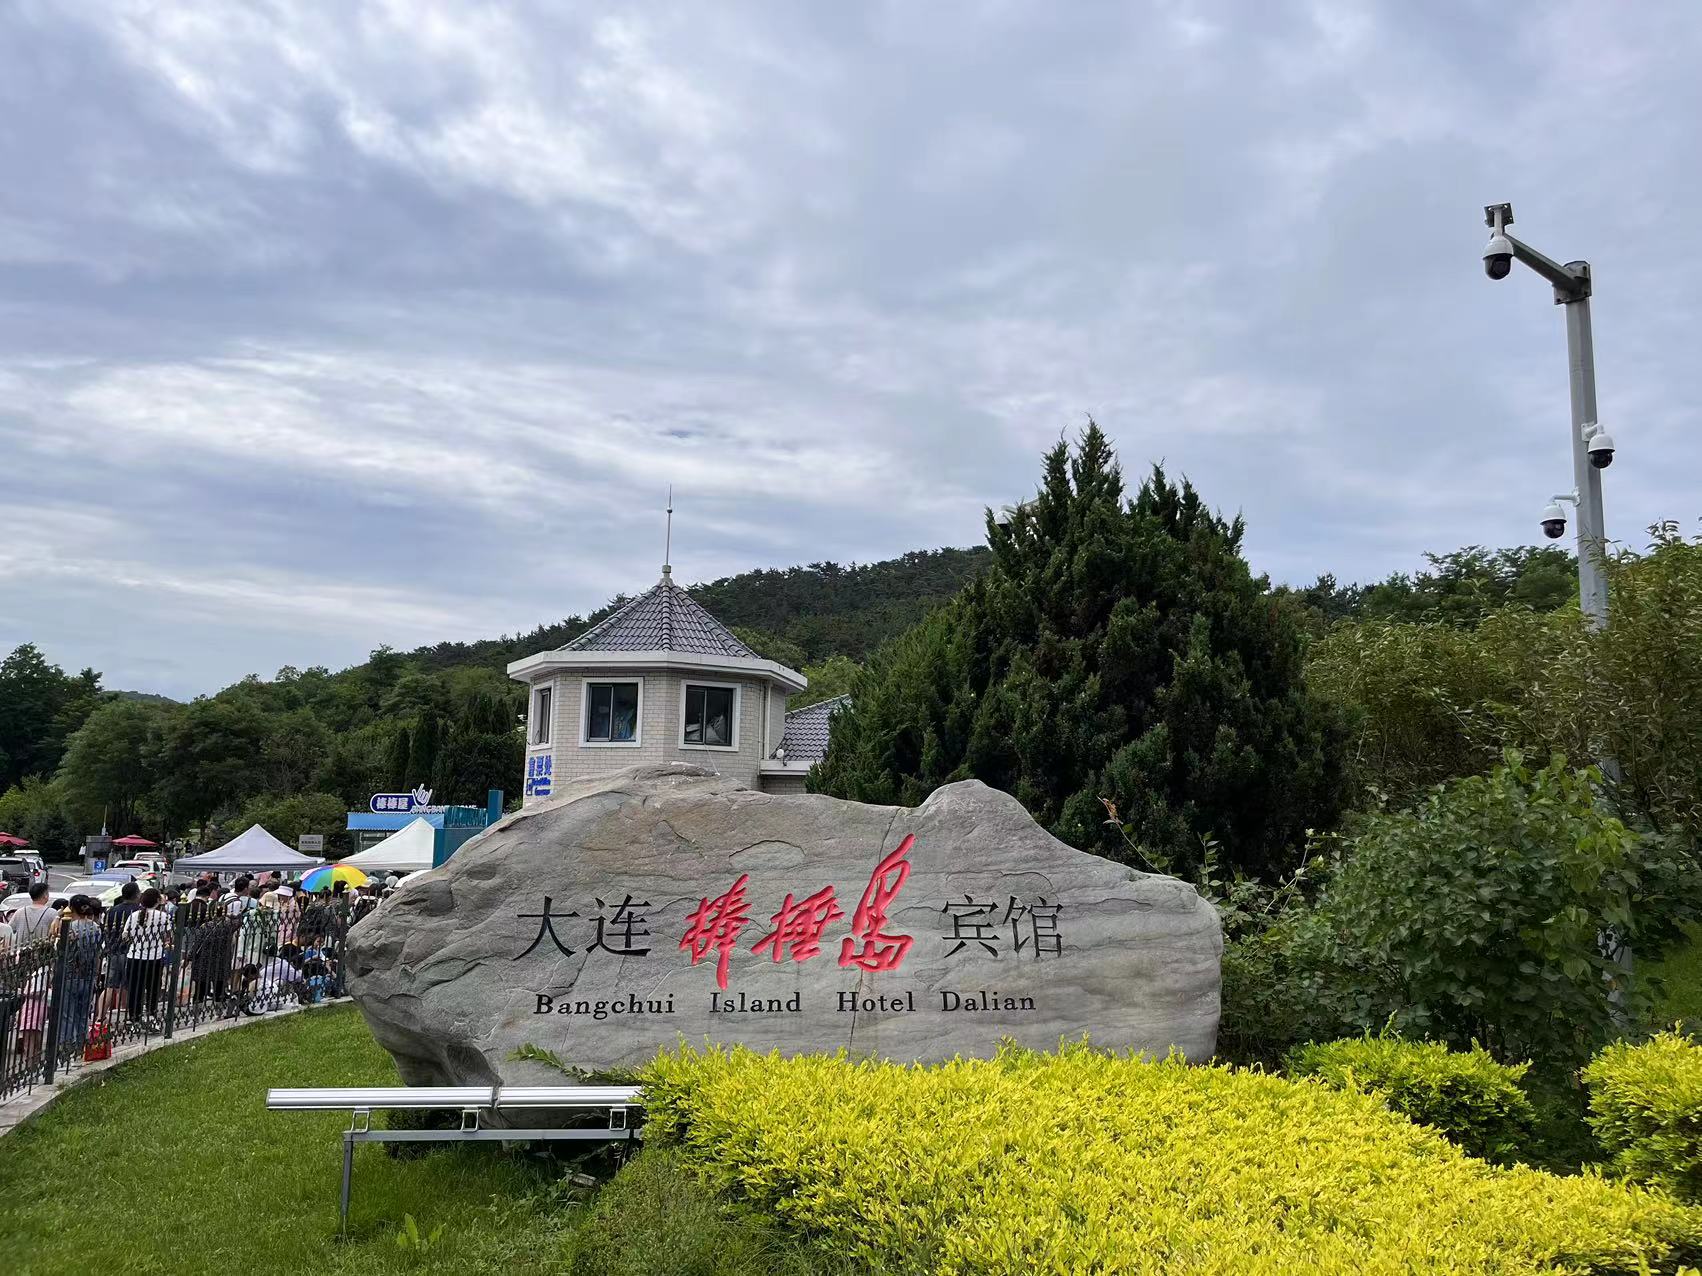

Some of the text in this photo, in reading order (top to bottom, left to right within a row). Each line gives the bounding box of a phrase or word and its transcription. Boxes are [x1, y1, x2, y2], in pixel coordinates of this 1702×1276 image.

[513, 894, 651, 961] 大连
[943, 895, 1062, 960] 宾馆
[538, 991, 1037, 1021] Bangchui Island Hotel Dalian
